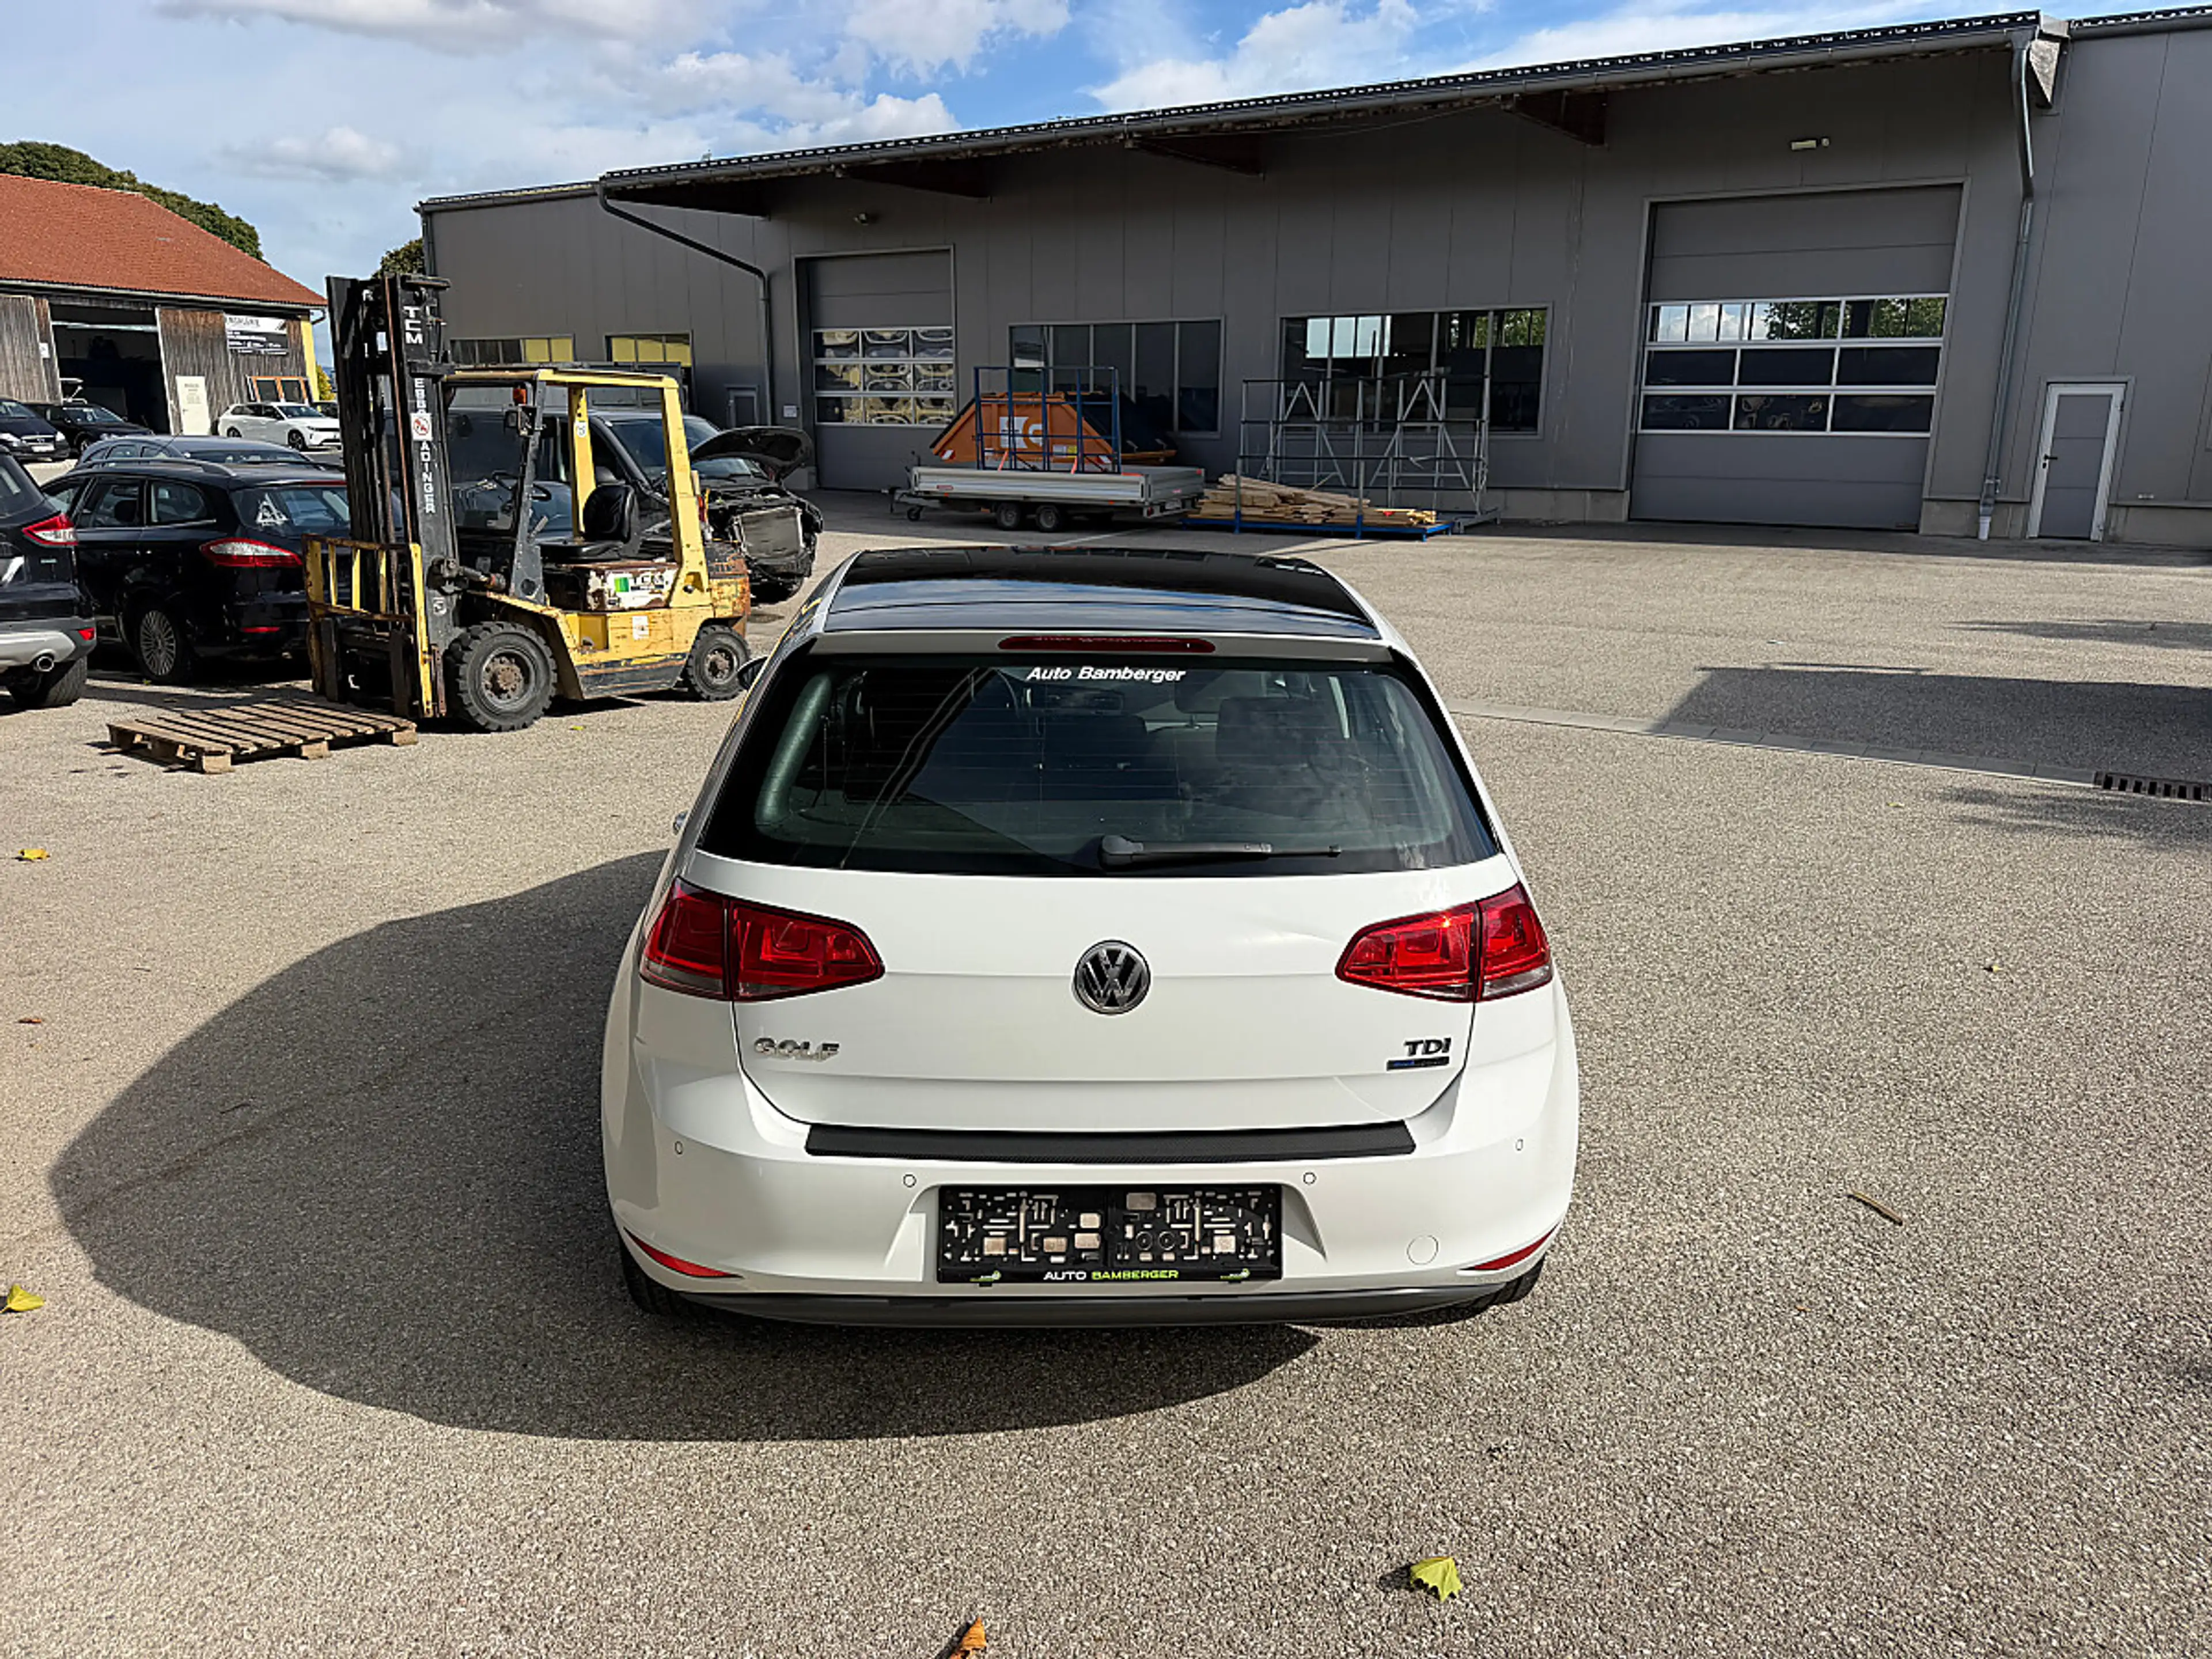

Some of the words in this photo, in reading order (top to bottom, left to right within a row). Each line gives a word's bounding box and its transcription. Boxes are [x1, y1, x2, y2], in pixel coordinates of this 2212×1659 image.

[403, 305, 423, 344] TCM
[1025, 666, 1072, 681] Auto
[1077, 666, 1186, 683] Bamberger
[754, 1036, 840, 1061] GOLF
[1404, 1037, 1452, 1056] TDI
[1043, 1271, 1087, 1281] AUTO
[1092, 1270, 1179, 1280] BAMBERGER
